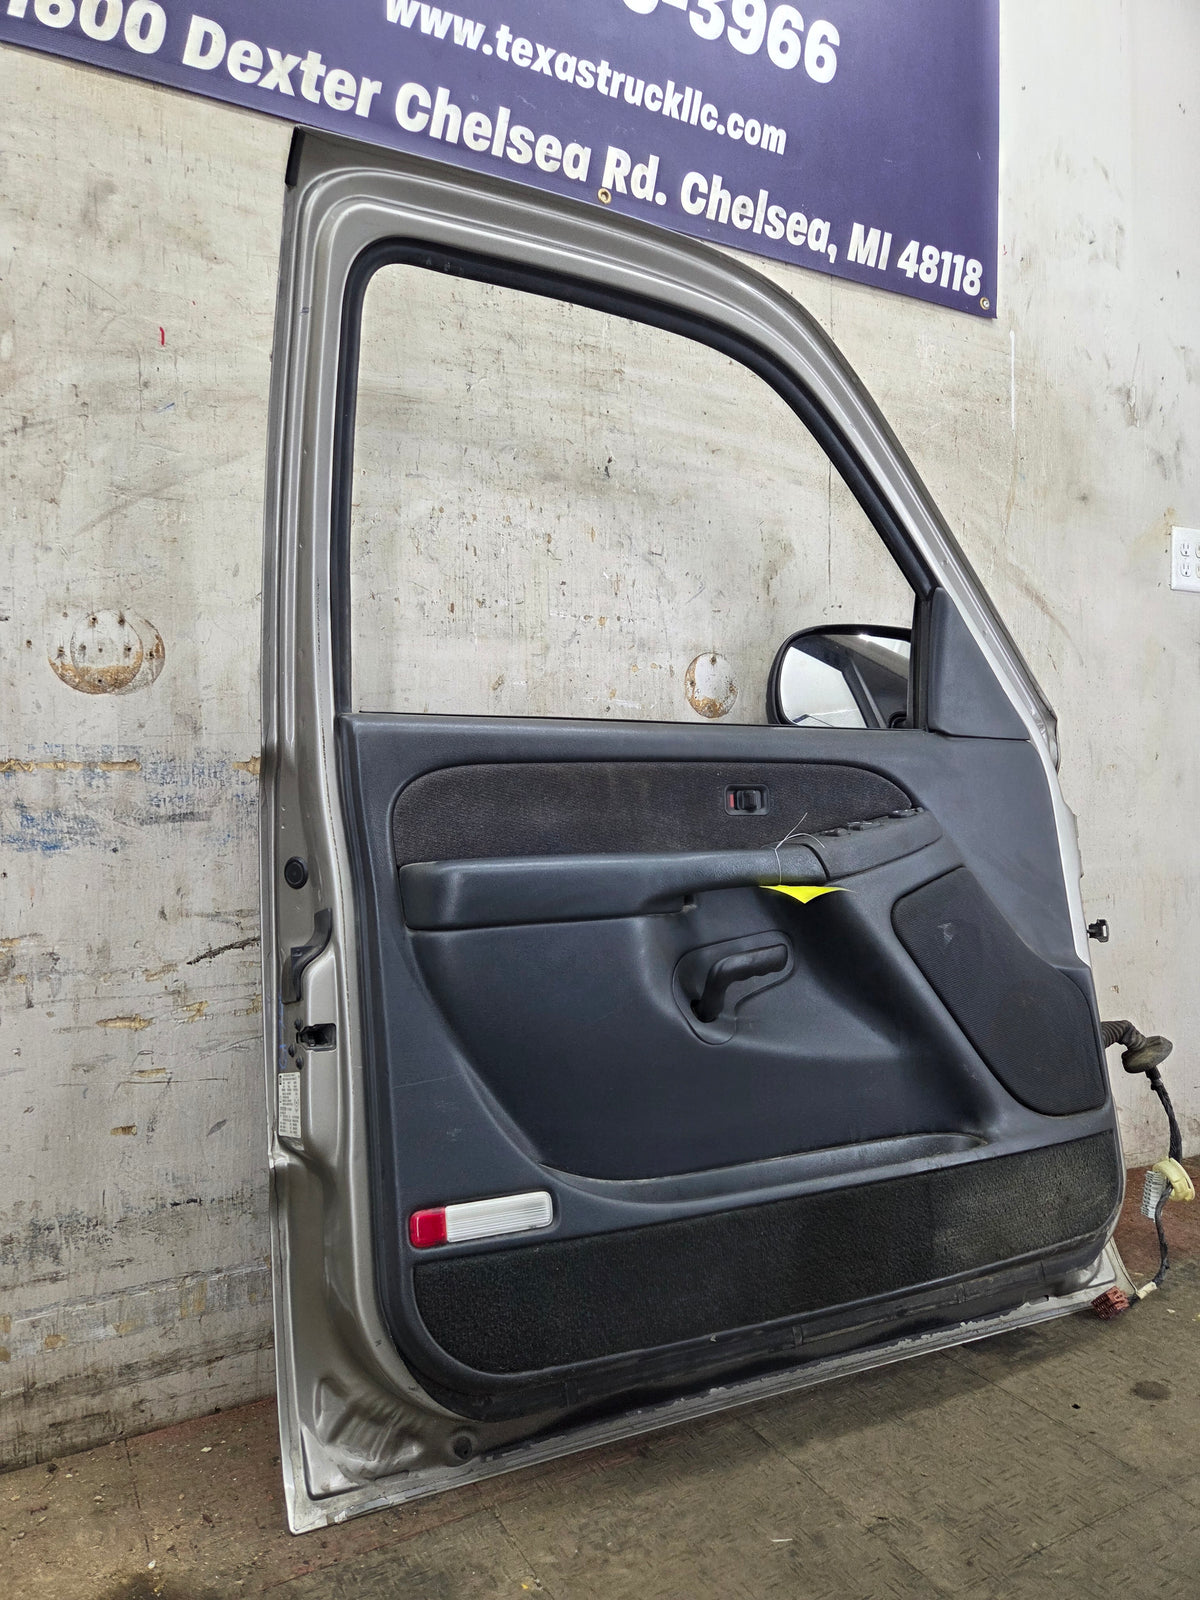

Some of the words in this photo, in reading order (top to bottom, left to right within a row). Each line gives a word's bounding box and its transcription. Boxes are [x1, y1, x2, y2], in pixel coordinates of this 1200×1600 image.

[385, 0, 787, 156] www.texastruckllc.com
[622, 0, 841, 84] -3966
[6, 0, 167, 55] 800
[181, 14, 383, 118] Dexter
[394, 82, 592, 183] Chelsea
[597, 145, 667, 206] Rd.
[680, 171, 838, 264] Chelsea,
[846, 222, 893, 271] MI
[896, 240, 983, 297] 48118
